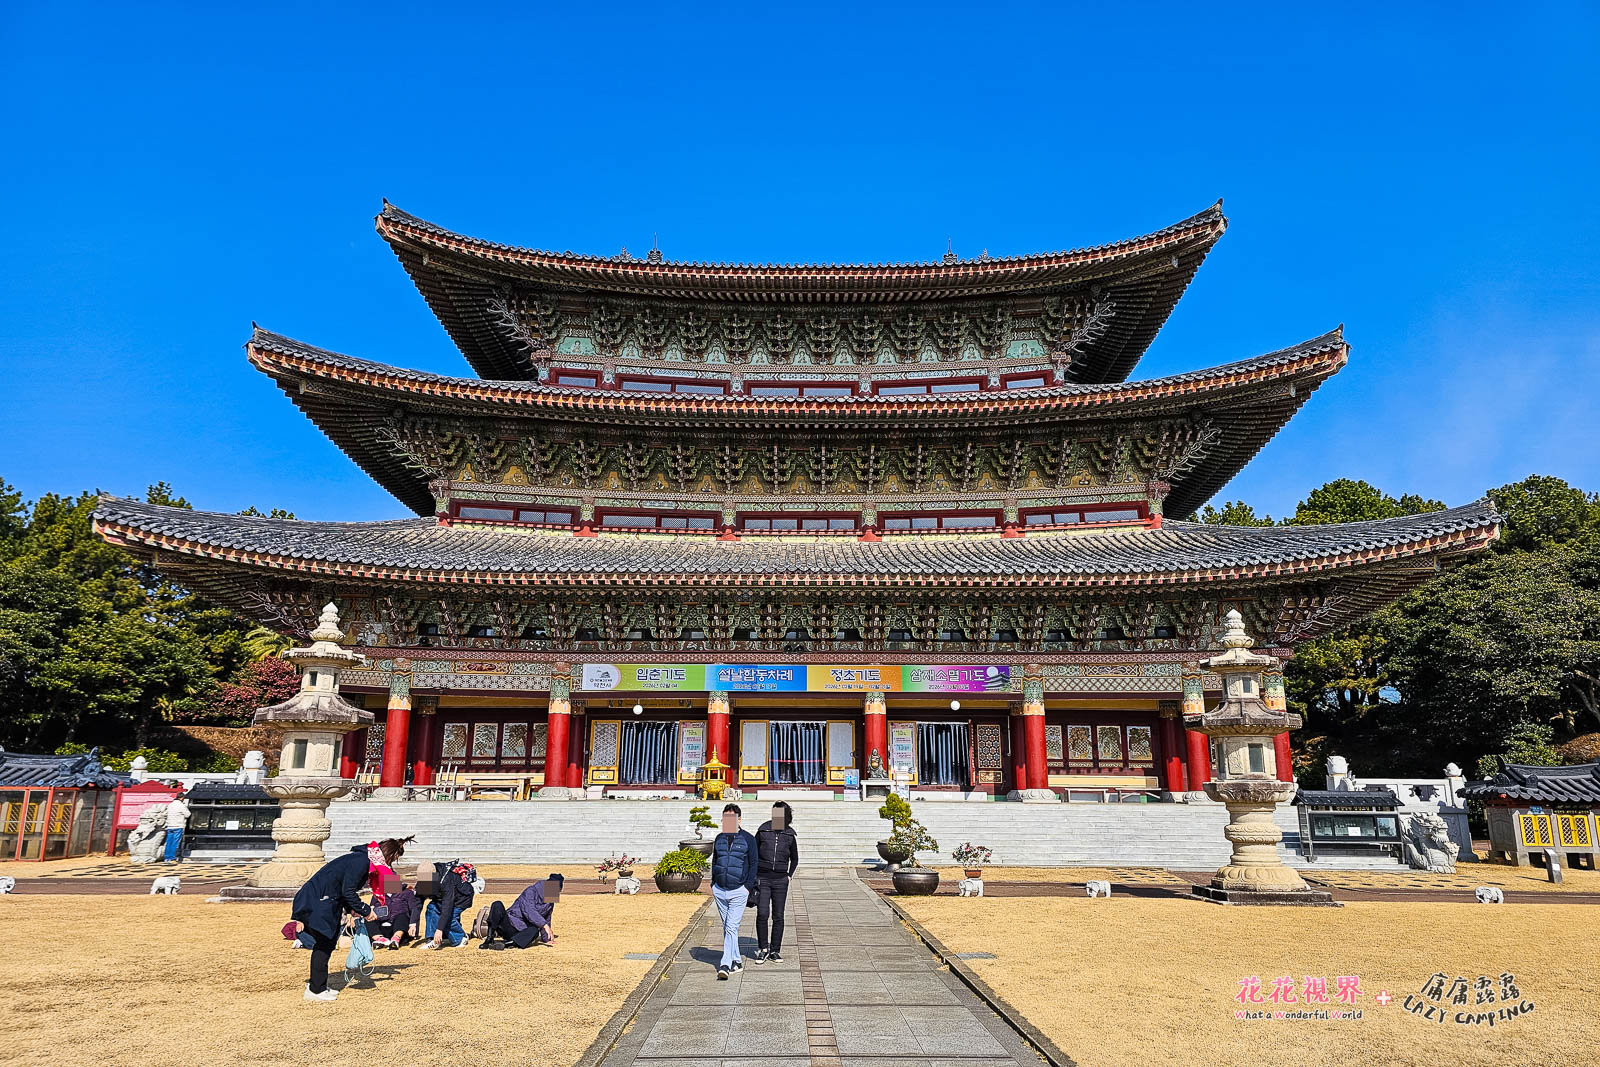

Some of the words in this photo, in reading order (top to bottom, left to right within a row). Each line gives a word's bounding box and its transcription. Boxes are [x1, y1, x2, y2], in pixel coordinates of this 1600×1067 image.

[637, 668, 686, 681] 입춘기도
[718, 668, 793, 682] 설날합동차례
[831, 669, 880, 682] 정초기도
[910, 669, 985, 682] 삼재소멸기도
